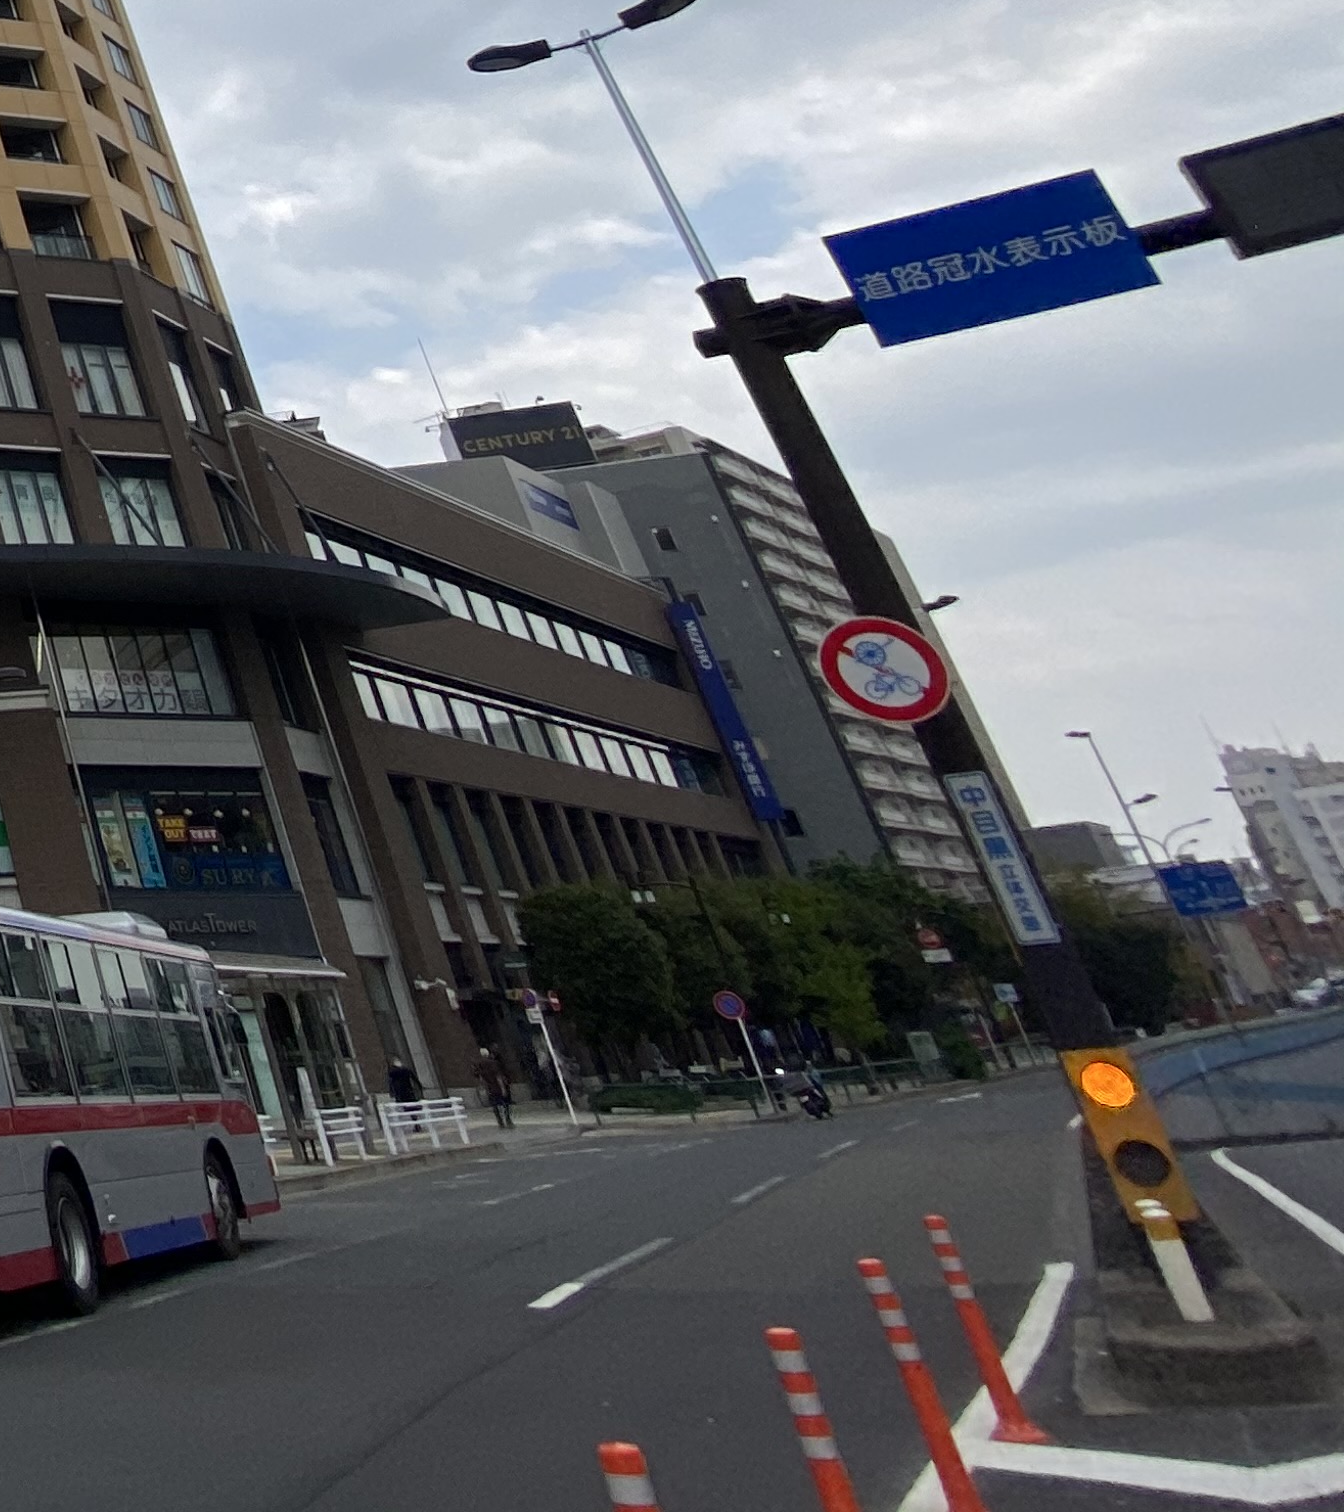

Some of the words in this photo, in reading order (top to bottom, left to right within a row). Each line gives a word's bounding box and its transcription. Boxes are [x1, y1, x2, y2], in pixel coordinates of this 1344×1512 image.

[855, 214, 1128, 302] 道路冠水表示板
[463, 429, 555, 453] CENTURY
[560, 426, 580, 440] 21
